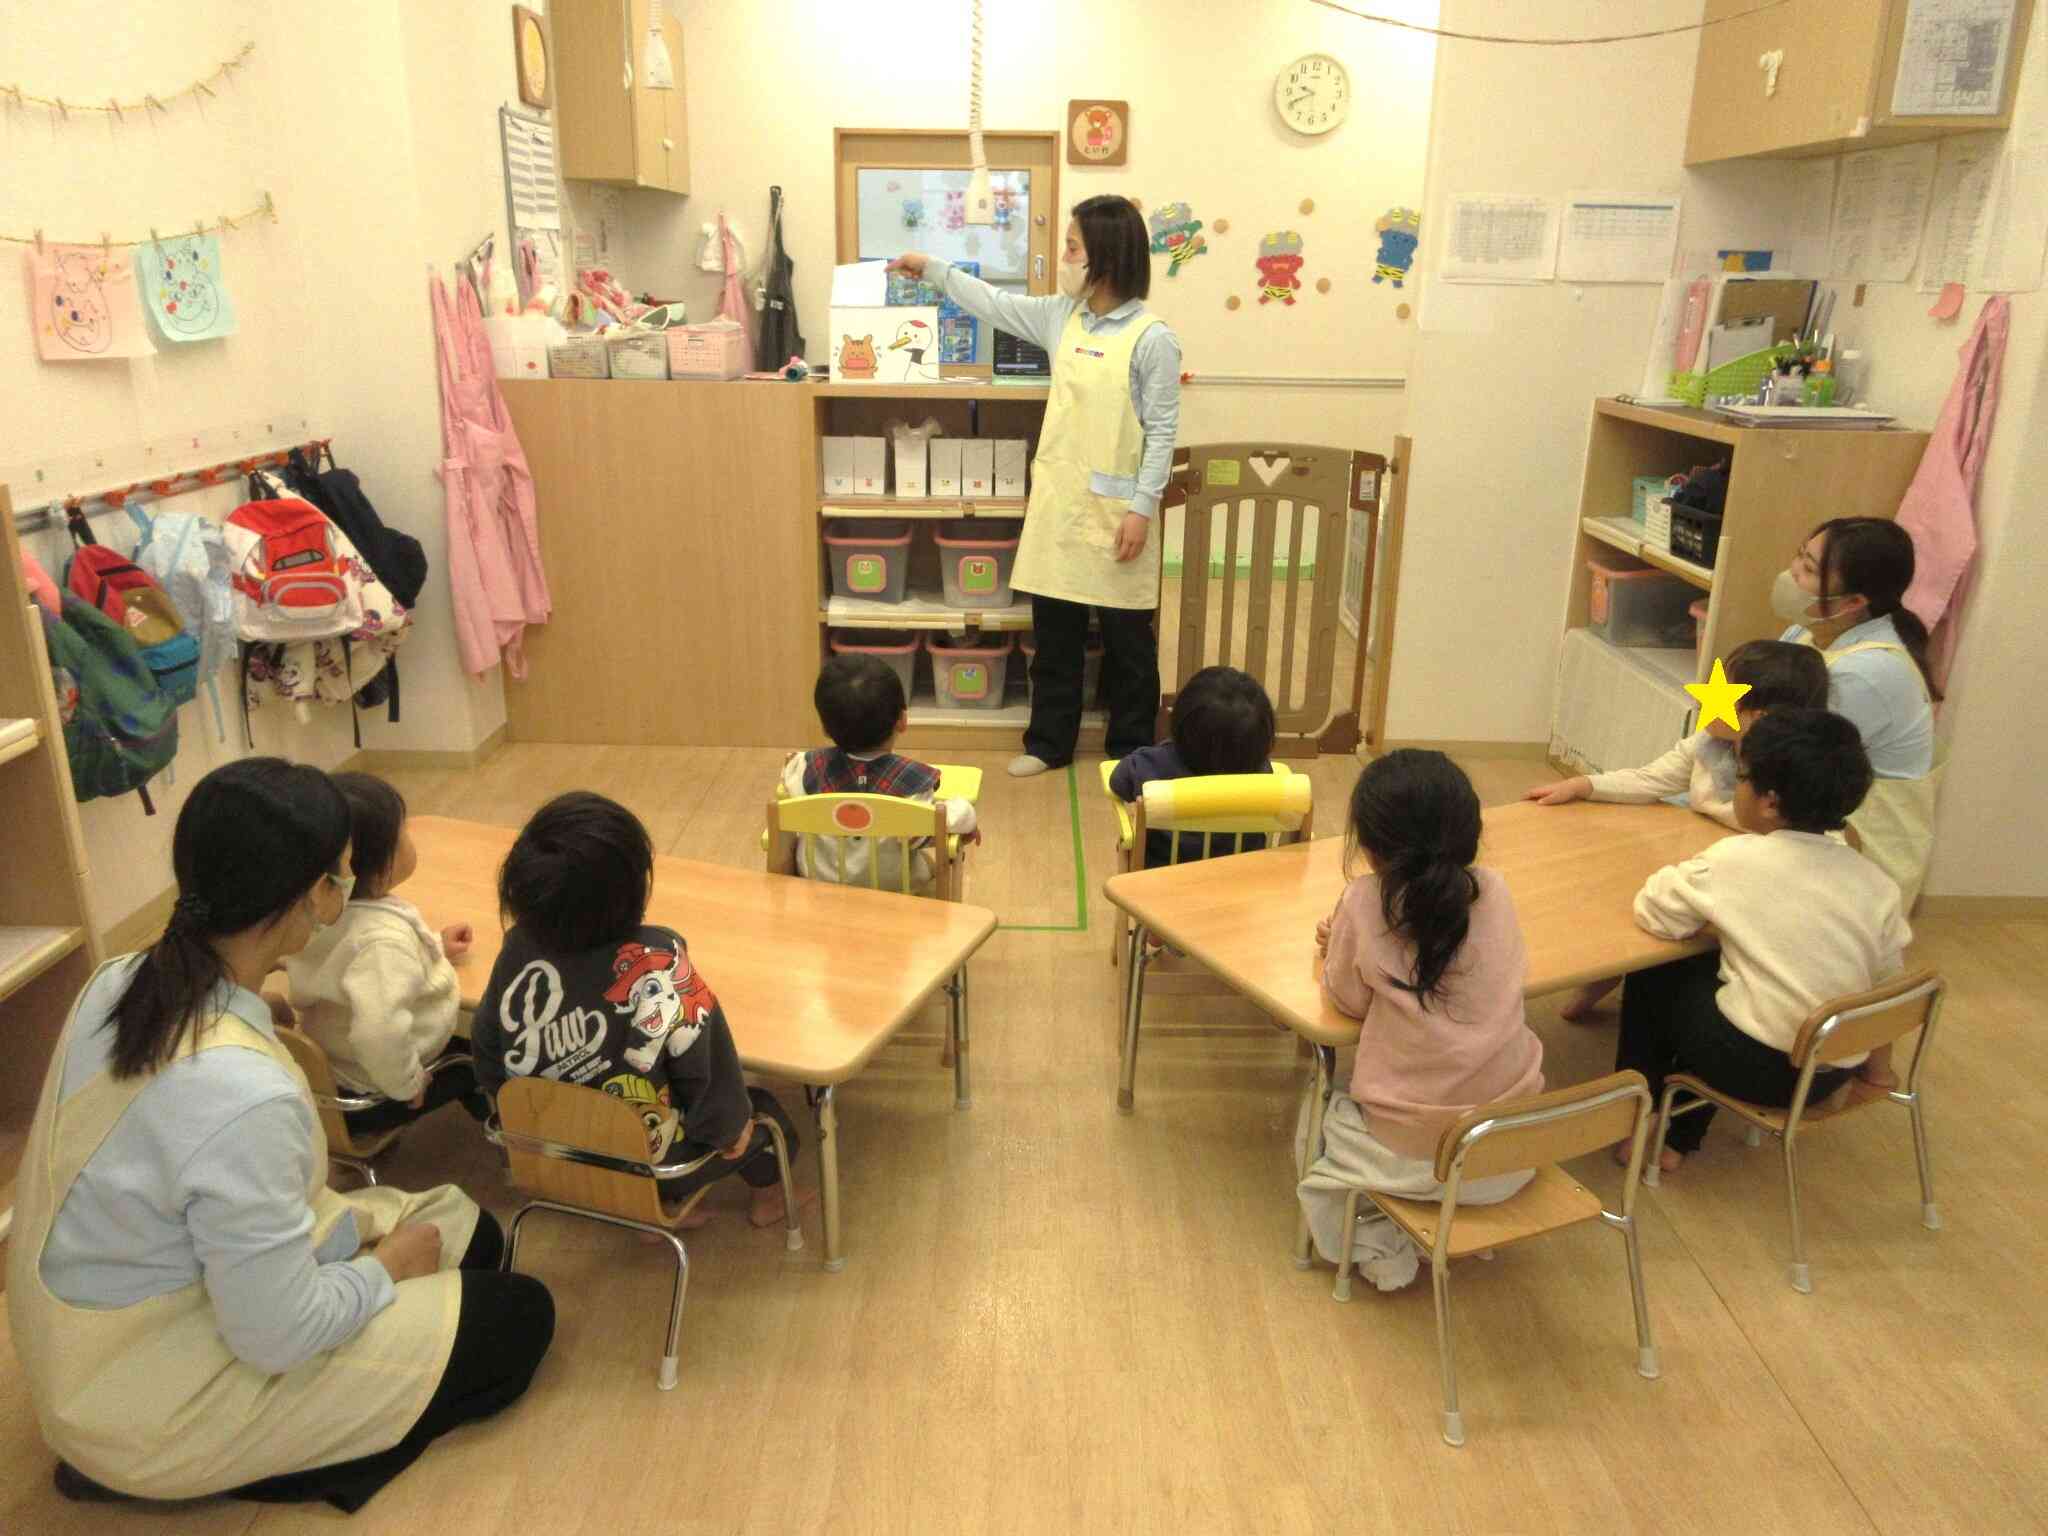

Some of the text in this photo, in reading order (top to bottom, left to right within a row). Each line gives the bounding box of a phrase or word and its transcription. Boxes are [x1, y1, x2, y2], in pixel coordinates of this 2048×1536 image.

[1300, 63, 1307, 74] 11
[1312, 61, 1322, 71] 12
[1326, 65, 1331, 75] 1
[1290, 73, 1299, 84] 10
[1334, 75, 1341, 86] 2
[1286, 87, 1293, 97] 9
[1336, 88, 1343, 99] 3
[1329, 103, 1336, 113] 4
[1296, 111, 1302, 121] 7
[1307, 114, 1315, 125] 6
[1320, 112, 1328, 122] 5
[500, 959, 608, 1076] Paw
